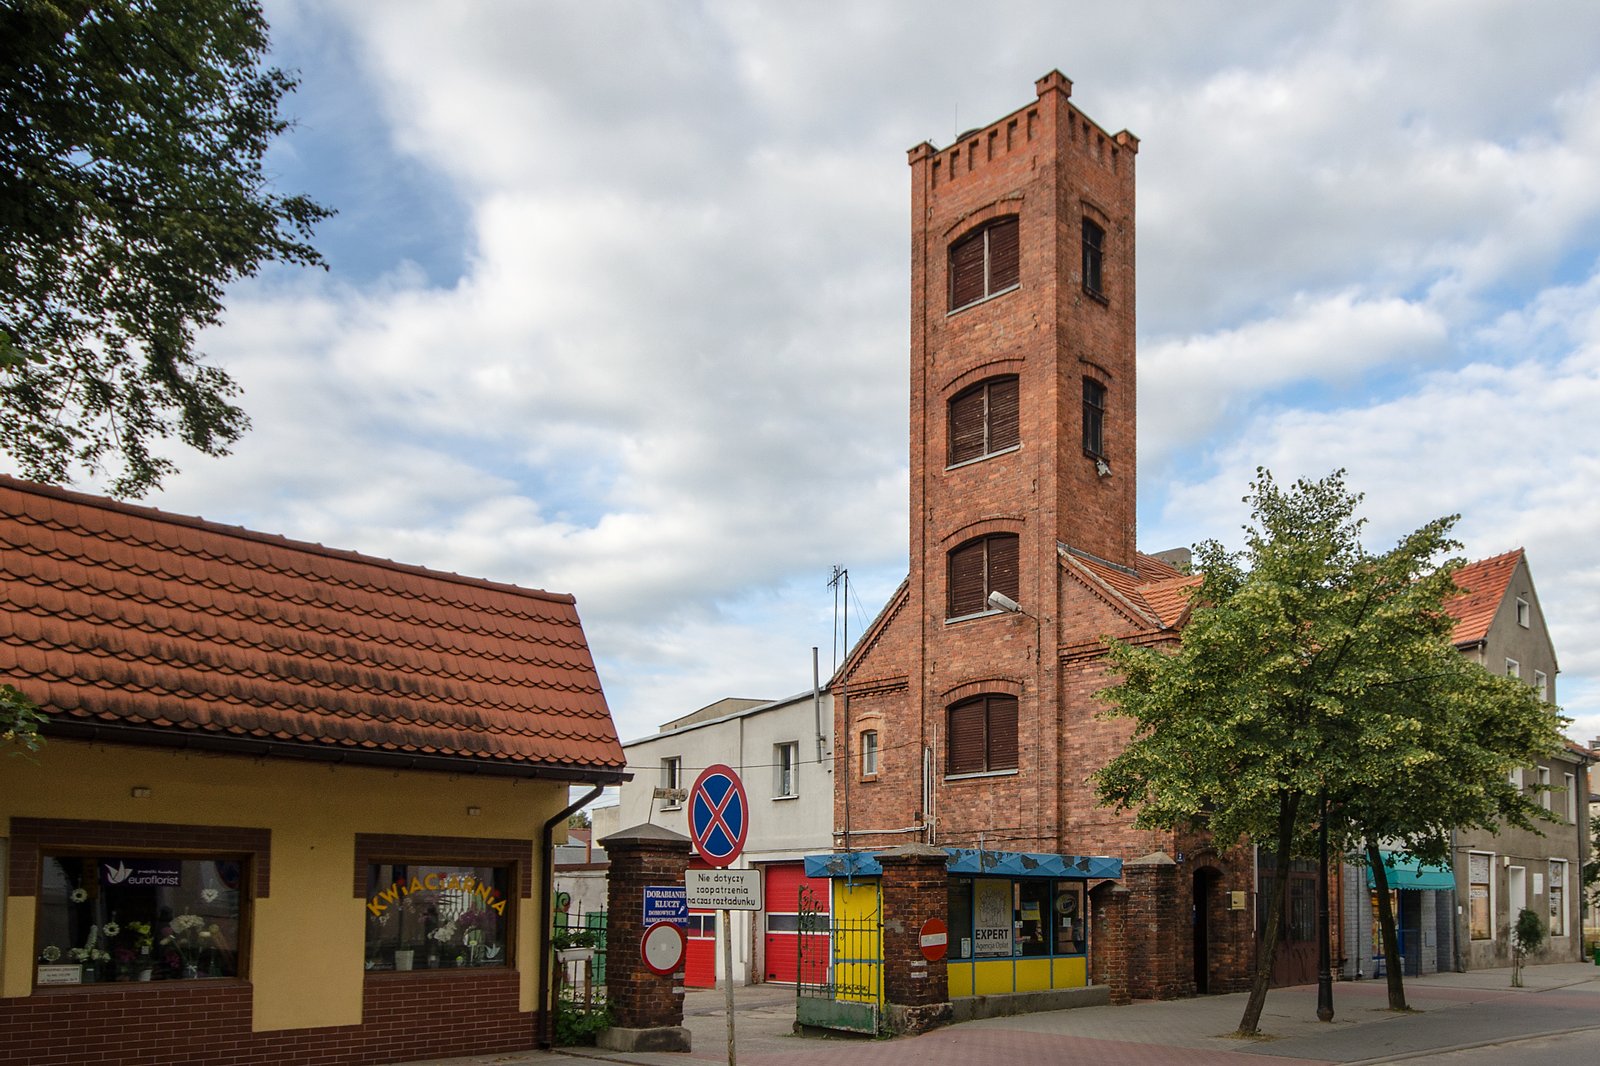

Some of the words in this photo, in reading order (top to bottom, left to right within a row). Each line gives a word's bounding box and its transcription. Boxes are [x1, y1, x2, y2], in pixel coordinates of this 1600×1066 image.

[128, 875, 179, 885] euroflorist
[698, 874, 710, 882] Nie
[713, 874, 744, 884] dotyczy
[646, 890, 687, 898] DORABIANIE
[696, 886, 749, 895] zaopatrzenia
[655, 900, 681, 908] KLUCZY
[697, 897, 711, 905] czas
[712, 896, 756, 906] rozładunku
[975, 929, 1009, 940] EXPERT
